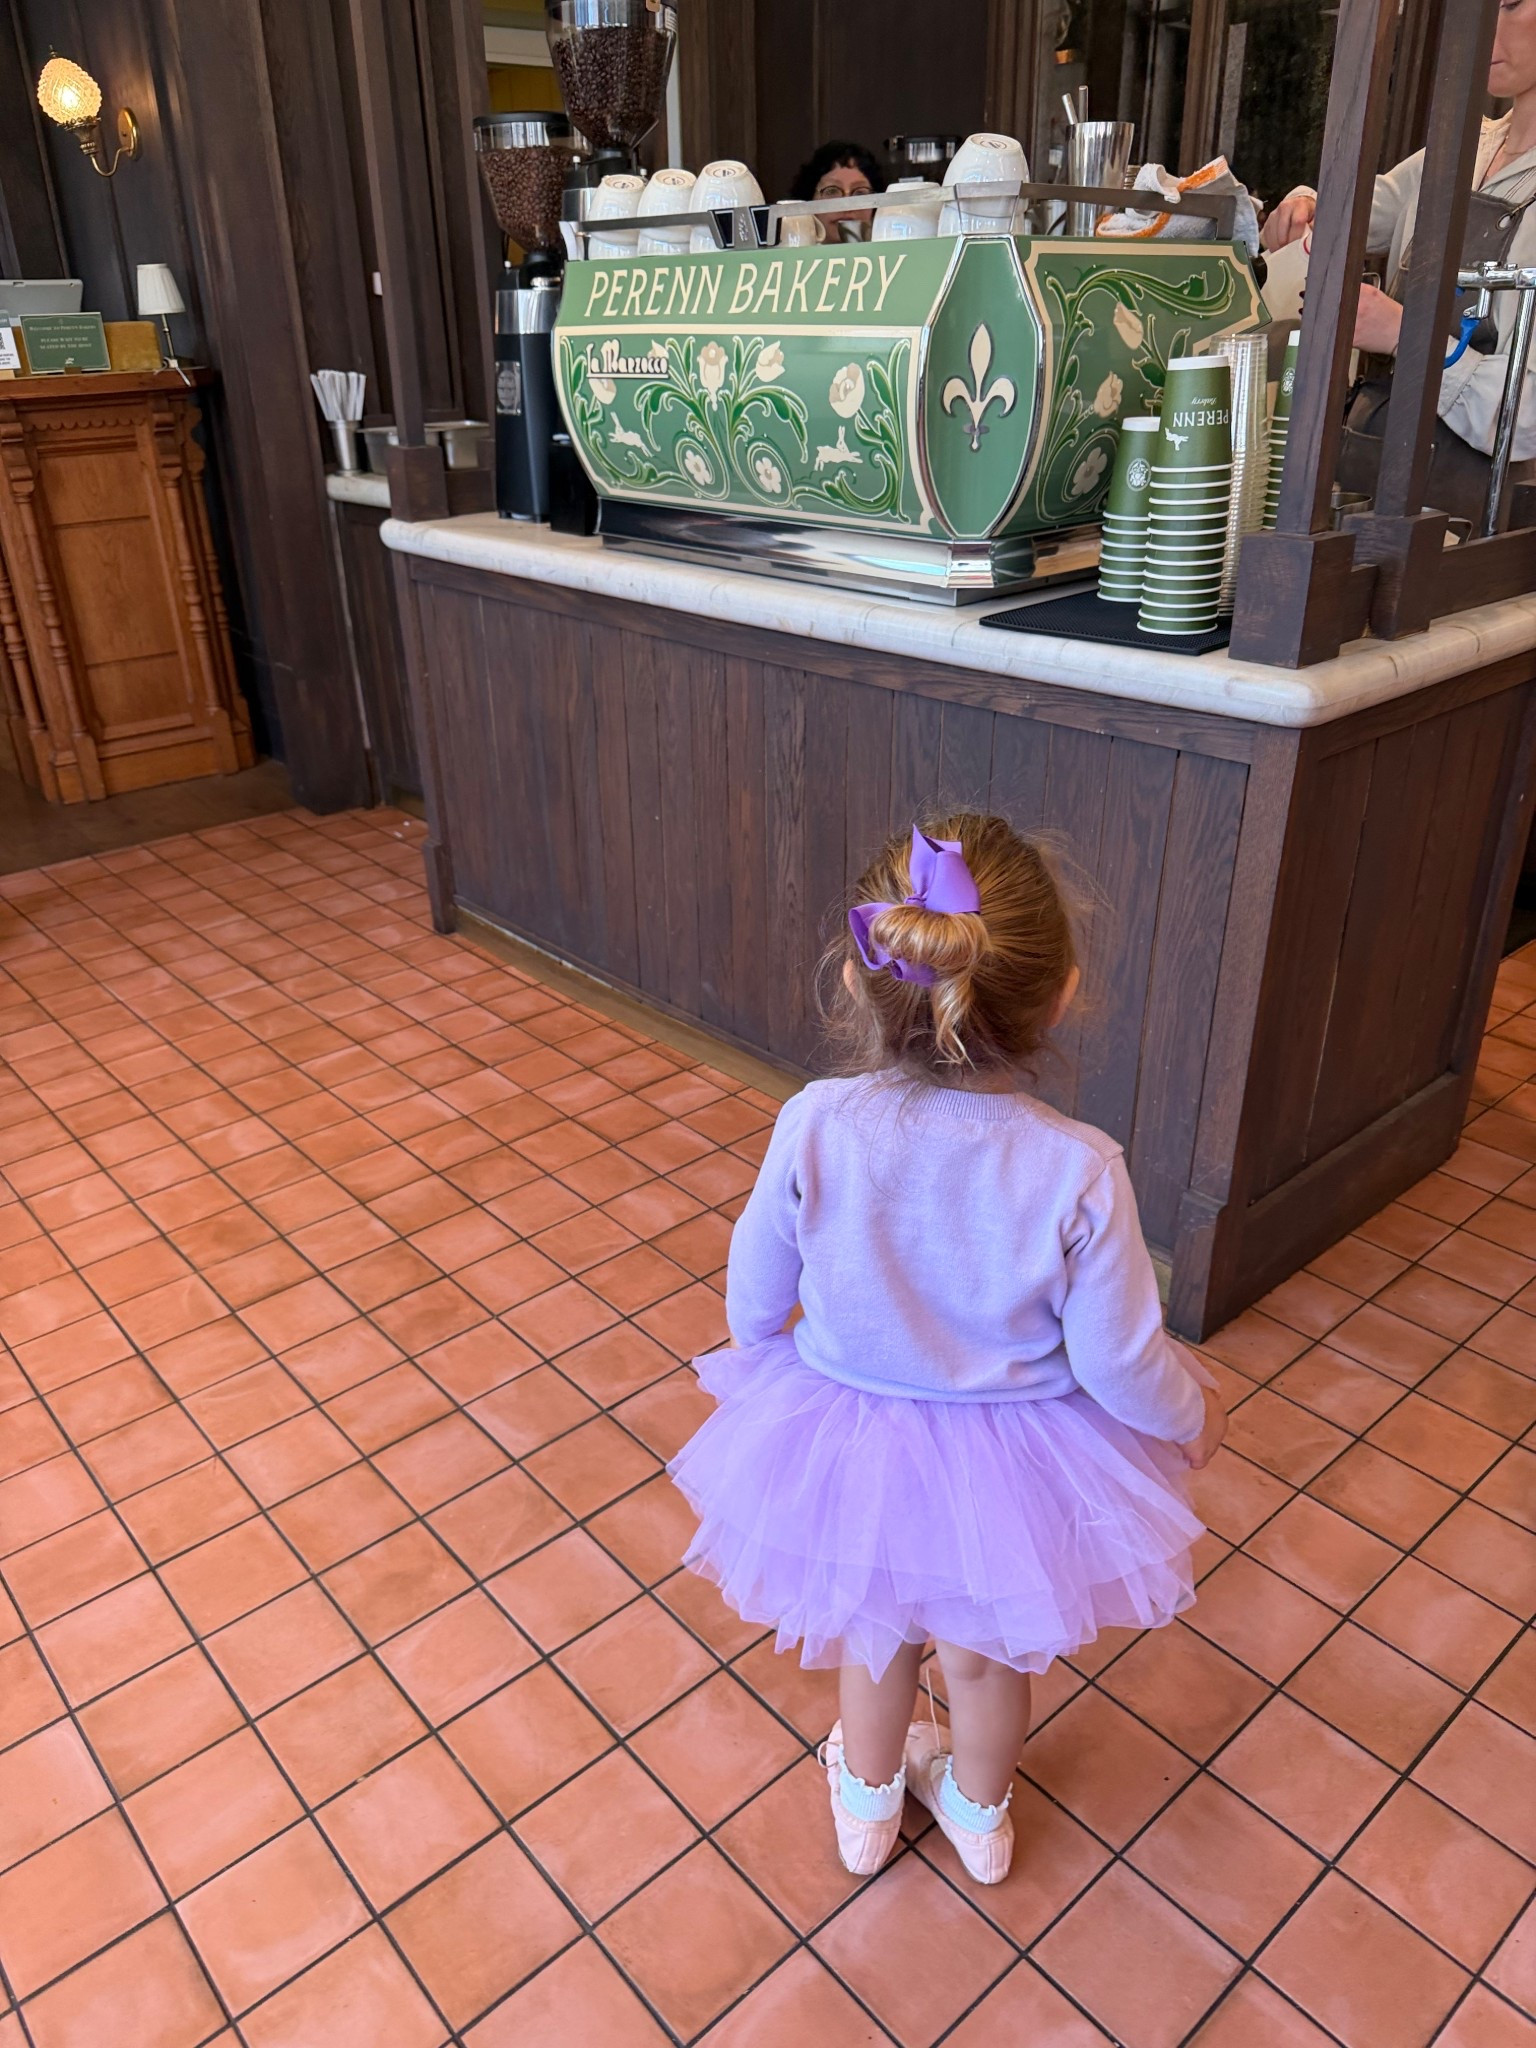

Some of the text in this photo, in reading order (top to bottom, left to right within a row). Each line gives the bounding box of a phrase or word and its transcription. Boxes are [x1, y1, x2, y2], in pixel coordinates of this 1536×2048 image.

[584, 254, 907, 317] PERENN BAKERY
[600, 338, 668, 374] Marzocco
[1172, 408, 1229, 427] PERENN
